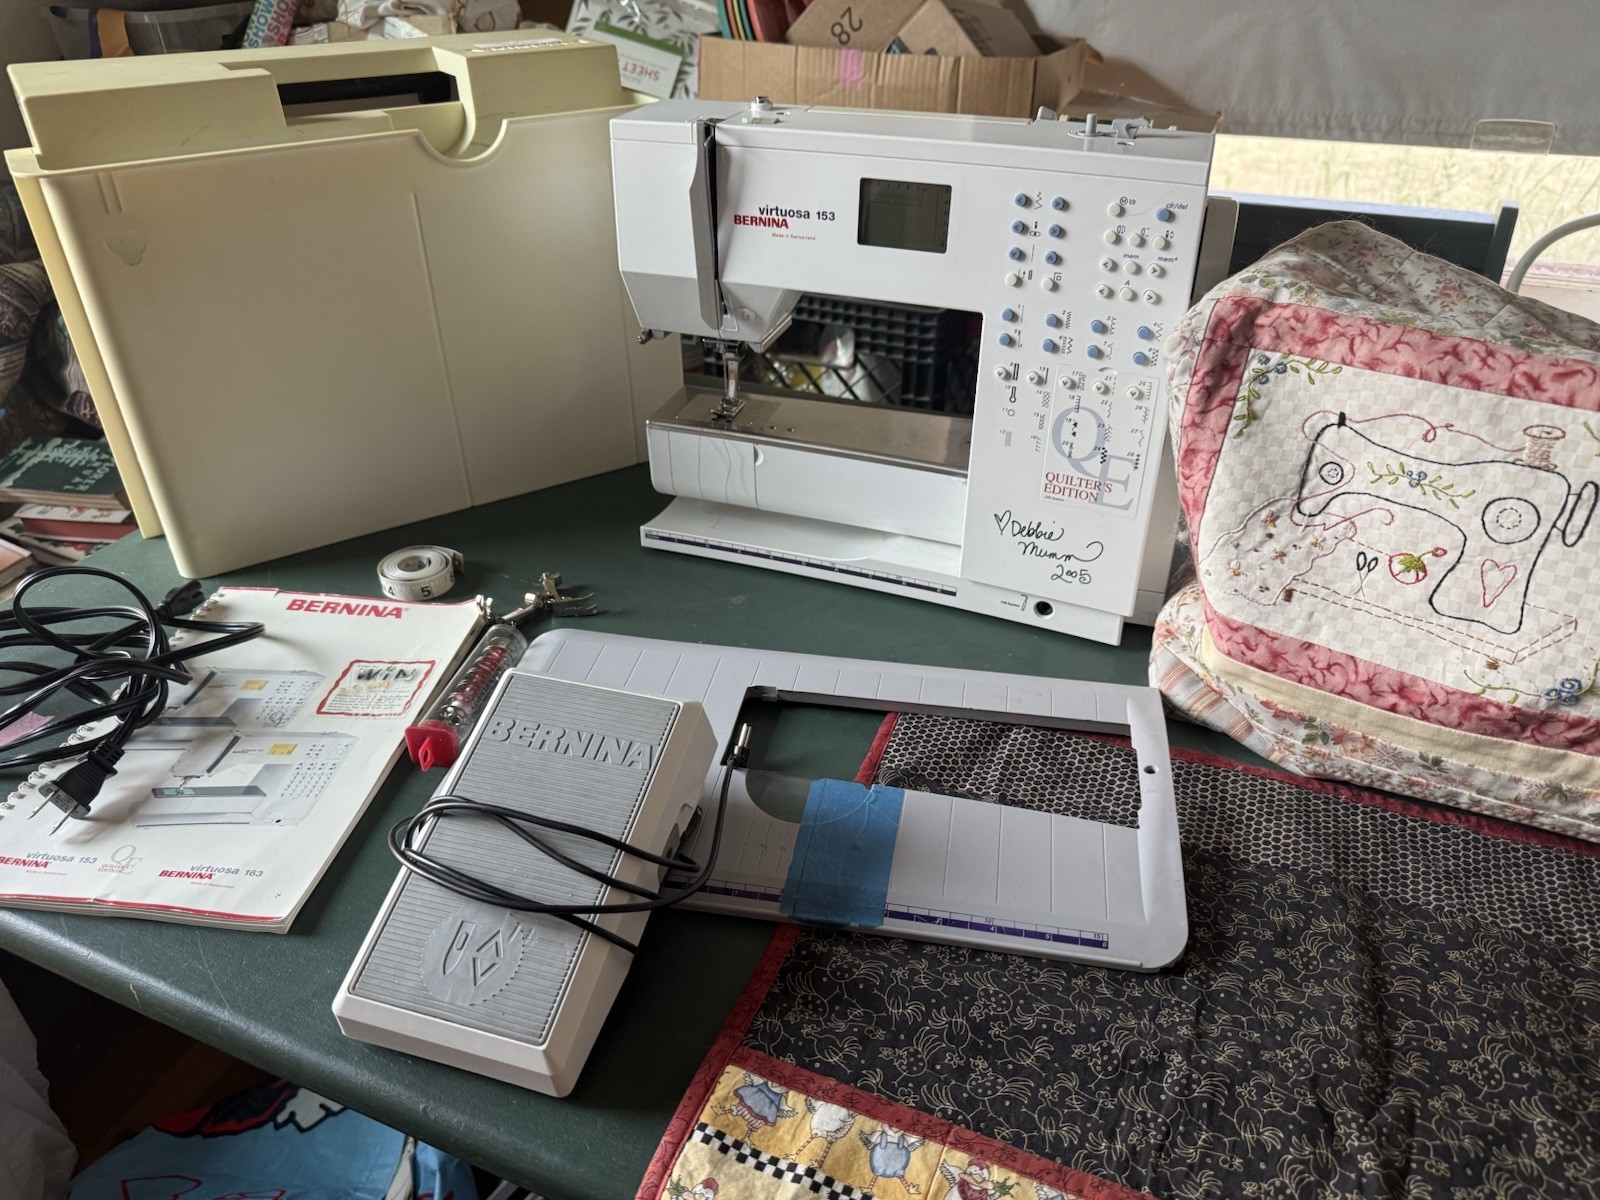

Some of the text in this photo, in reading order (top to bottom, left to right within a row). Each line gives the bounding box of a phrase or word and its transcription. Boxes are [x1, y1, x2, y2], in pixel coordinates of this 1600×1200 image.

[830, 6, 863, 45] 28
[622, 61, 660, 81] SHEET
[758, 204, 836, 221] virtuosa 153
[1166, 202, 1189, 210] clr/del
[733, 214, 789, 229] BERNINA
[1045, 471, 1112, 493] QUILTER'S
[1044, 483, 1099, 502] EDITION
[1011, 520, 1064, 541] Debbie
[1018, 541, 1104, 562] Mumm
[1051, 564, 1092, 585] 2005
[388, 586, 395, 596] 4
[421, 585, 431, 598] 5
[286, 599, 402, 619] BERNINA
[481, 716, 656, 771] BERNINA
[0, 856, 49, 868] BERNINA
[26, 851, 98, 864] virtuosa 153
[158, 869, 214, 880] BERNINA
[190, 864, 264, 877] virtuosa 163
